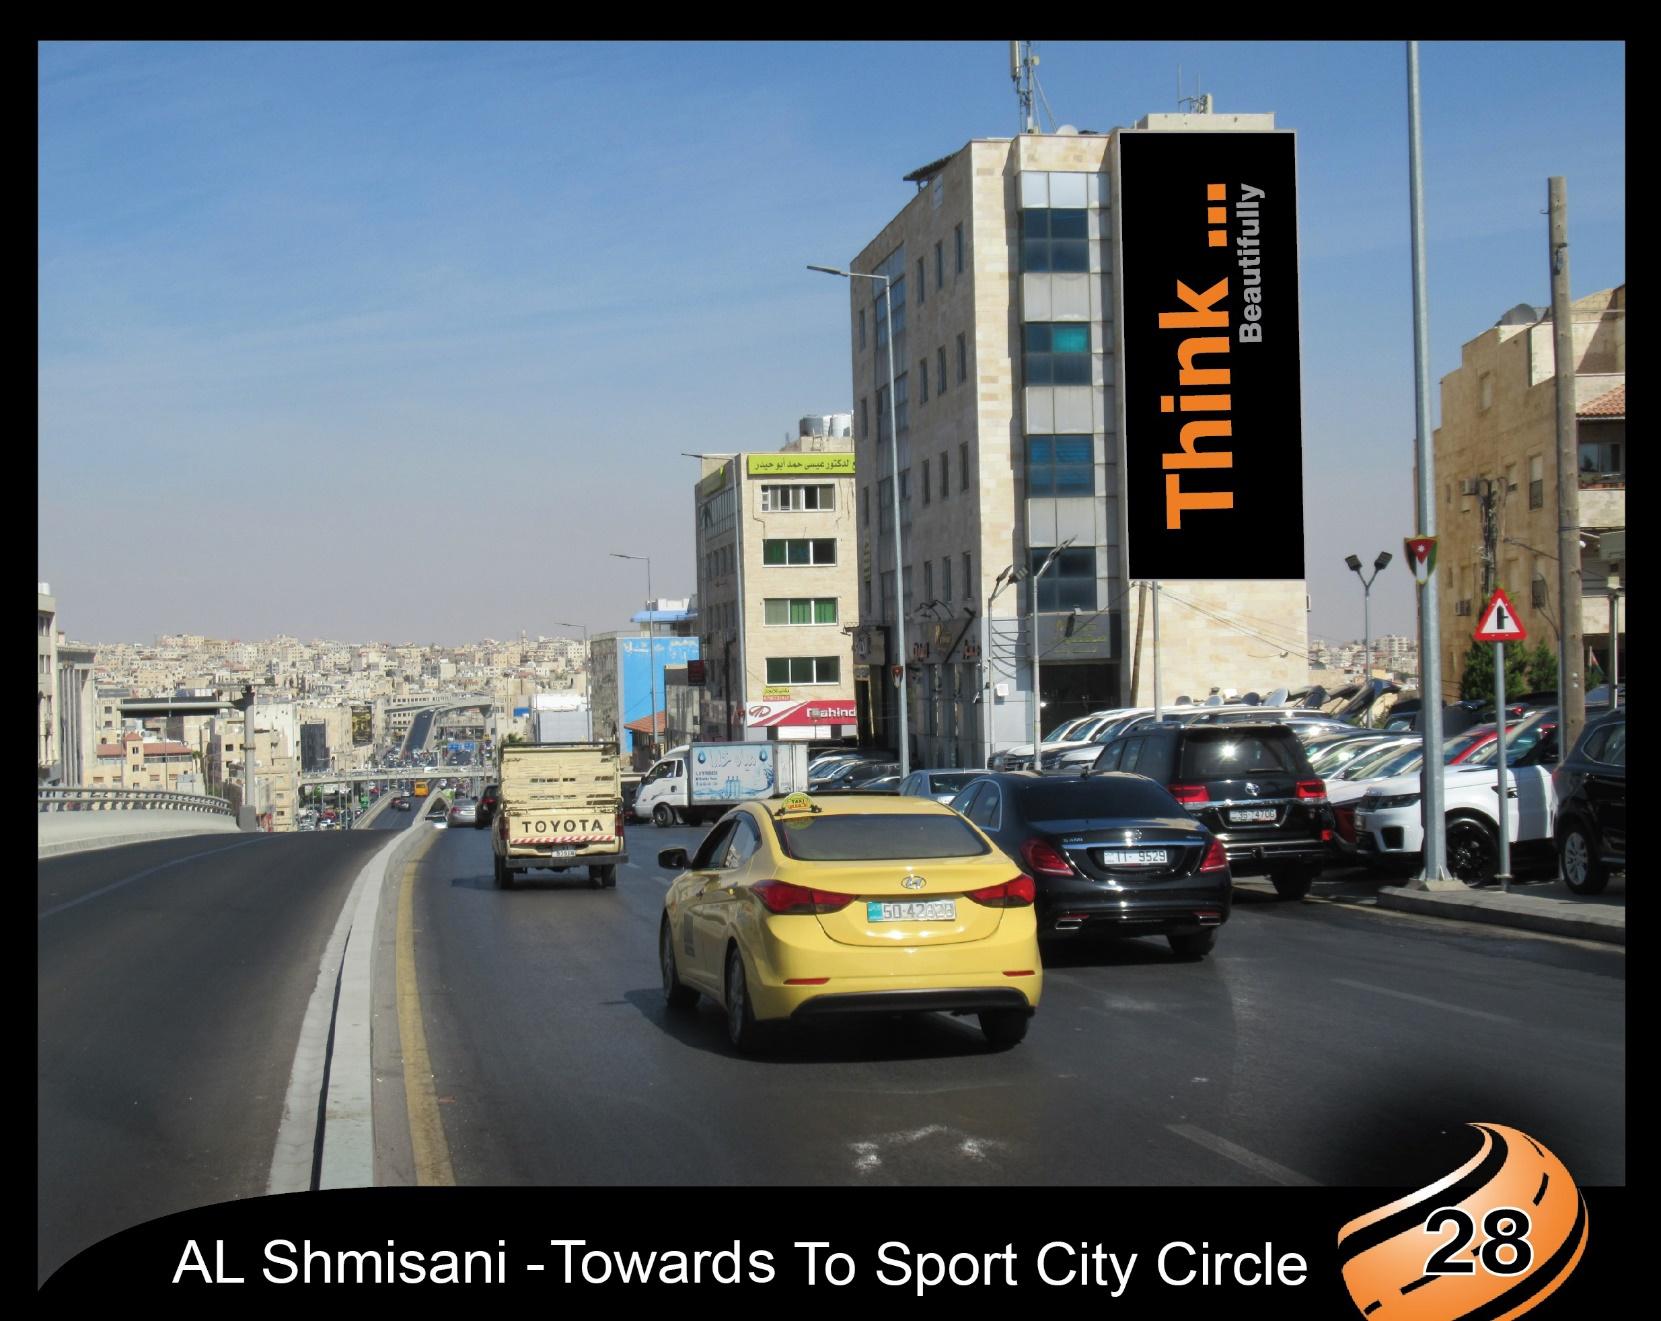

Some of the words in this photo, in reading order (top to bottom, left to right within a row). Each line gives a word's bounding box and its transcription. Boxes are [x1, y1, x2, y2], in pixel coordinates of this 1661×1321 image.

[1236, 184, 1265, 342] Beautifully
[1159, 278, 1233, 529] Think
[522, 819, 603, 833] TOYOTA
